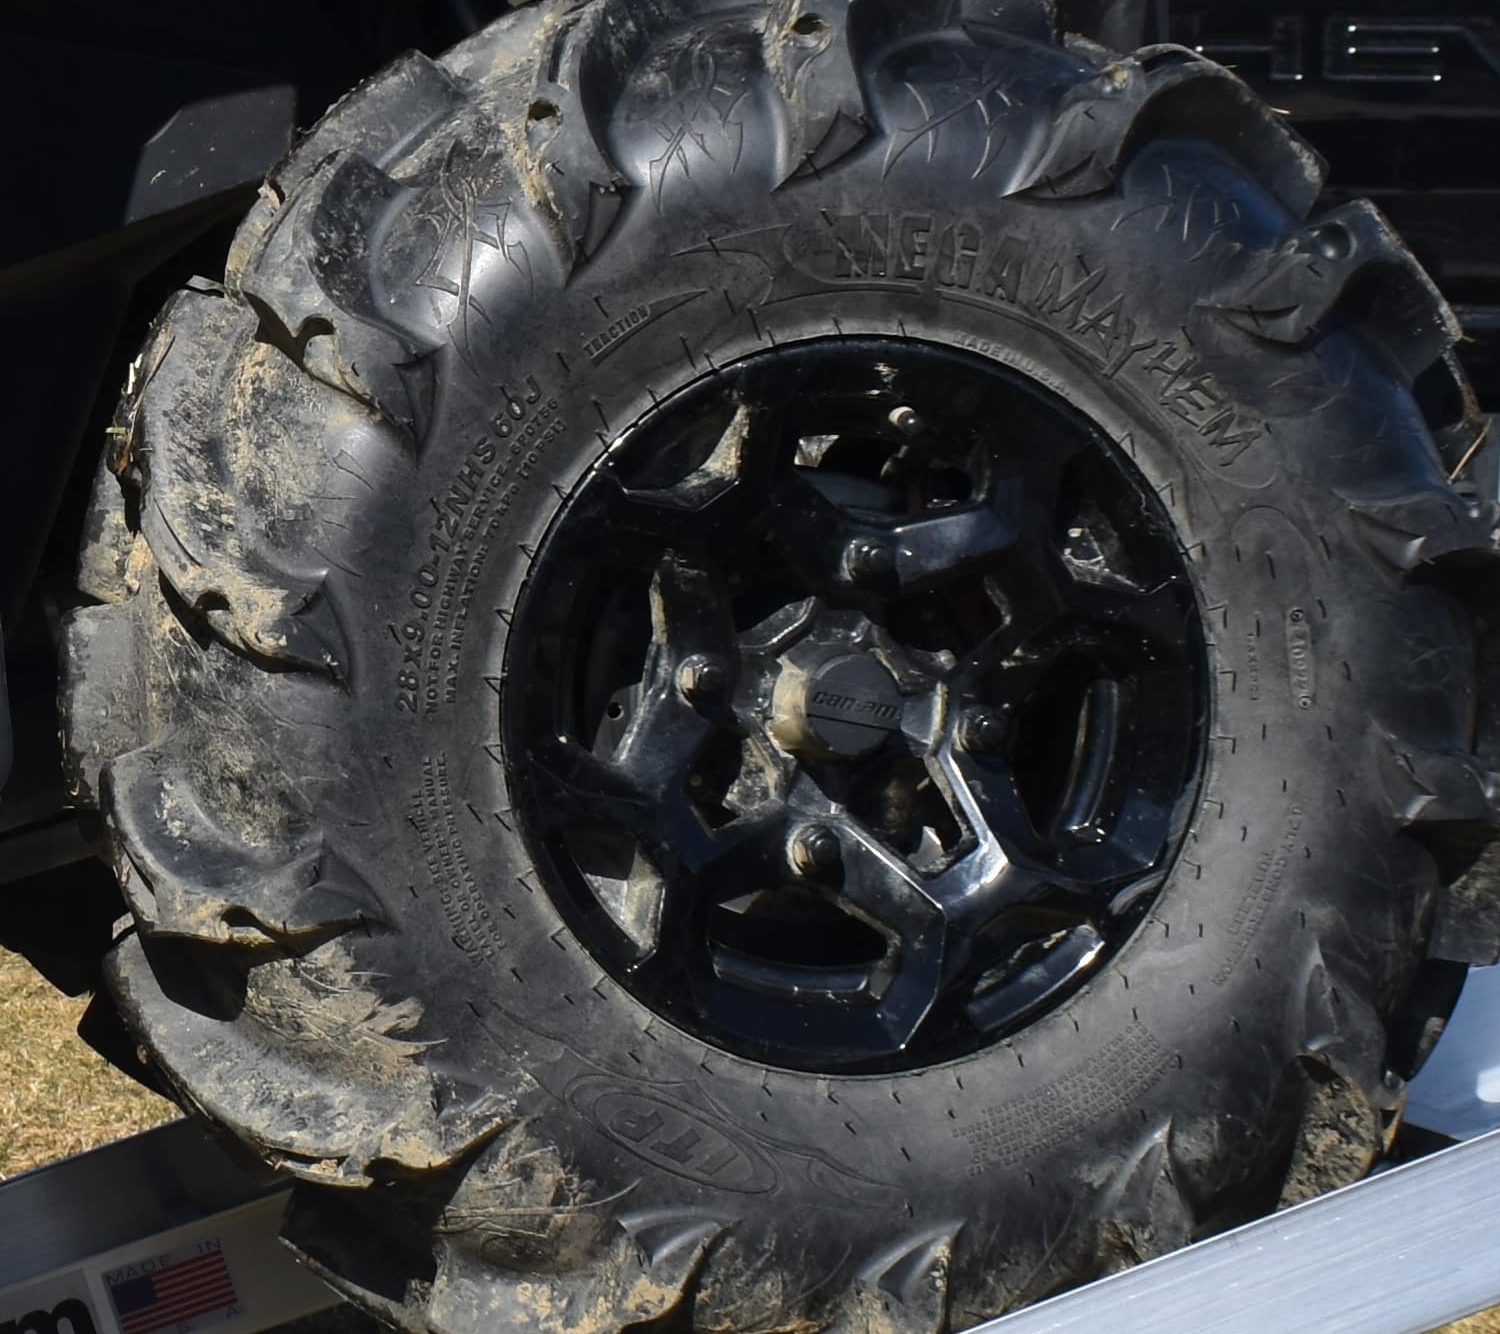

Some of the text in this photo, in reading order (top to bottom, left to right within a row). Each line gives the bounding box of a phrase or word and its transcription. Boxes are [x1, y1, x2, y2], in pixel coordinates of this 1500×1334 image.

[582, 304, 650, 358] TRACTION
[835, 208, 1266, 468] MEGA MAYHEM
[461, 462, 509, 541] SERVICE
[432, 540, 470, 630] HIGHWAY
[426, 630, 444, 671] FOR
[424, 675, 439, 714] NOT
[813, 690, 900, 718] can-am
[607, 1092, 740, 1182] ITP
